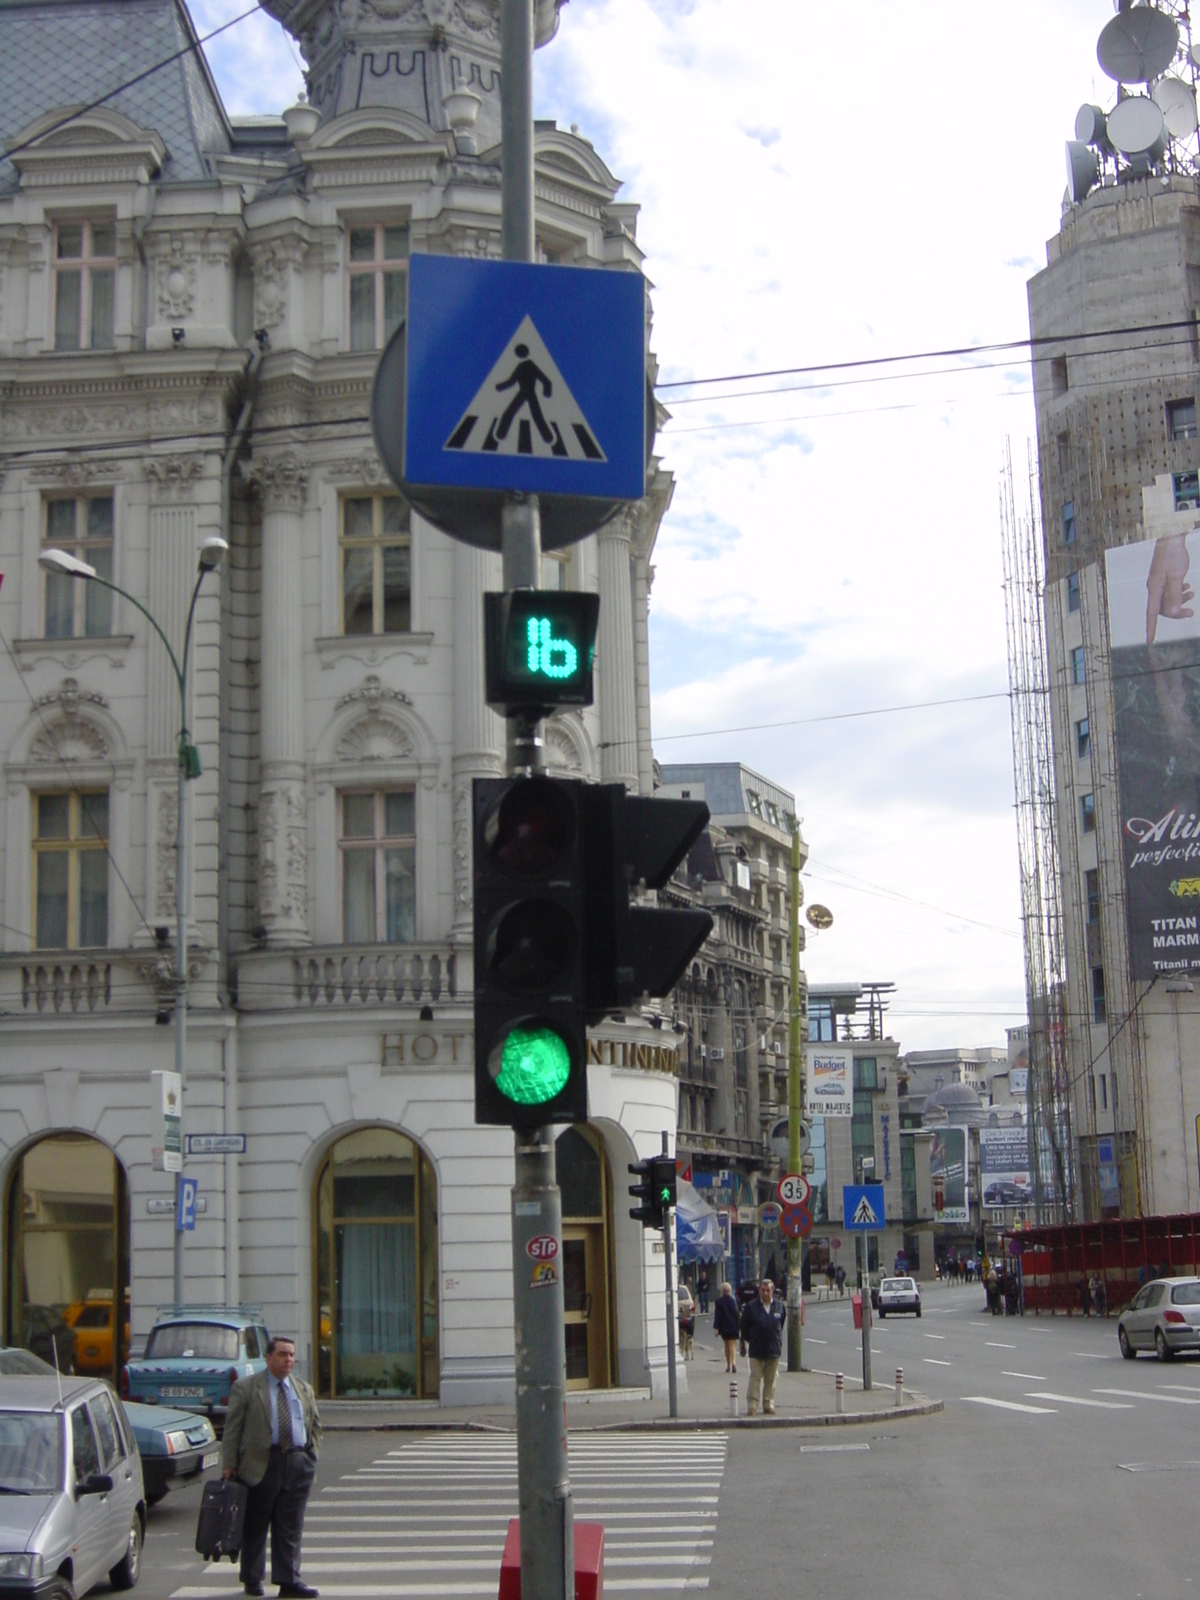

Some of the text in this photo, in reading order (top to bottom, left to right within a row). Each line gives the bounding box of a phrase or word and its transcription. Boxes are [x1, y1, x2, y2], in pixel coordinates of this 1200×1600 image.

[527, 617, 577, 678] 16
[1151, 916, 1197, 931] TITAN
[1153, 959, 1188, 970] Titanii
[814, 1060, 845, 1072] Budget
[809, 1102, 850, 1110] HOTEL MAJESTIC
[182, 1183, 194, 1225] P
[531, 1238, 556, 1256] STP
